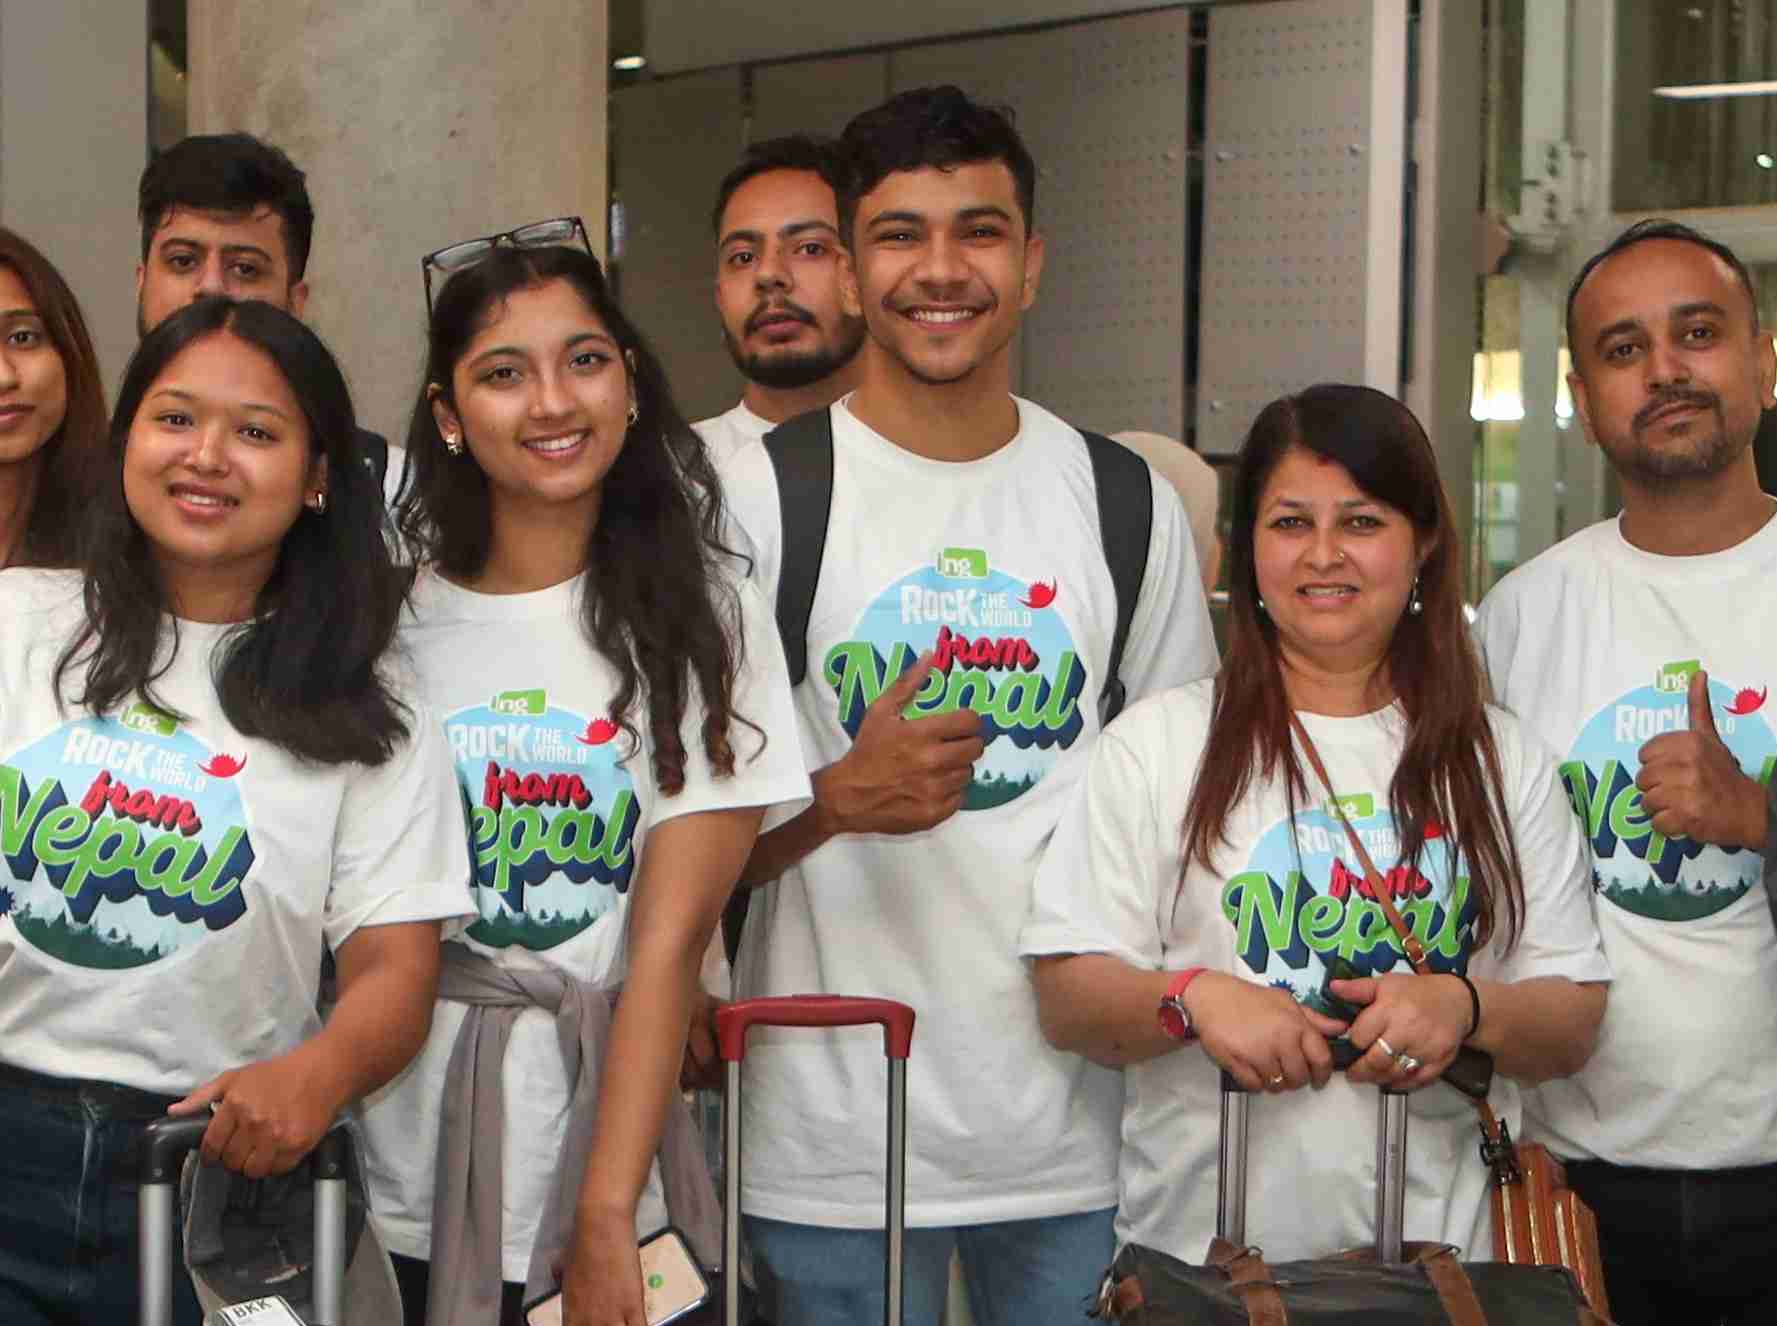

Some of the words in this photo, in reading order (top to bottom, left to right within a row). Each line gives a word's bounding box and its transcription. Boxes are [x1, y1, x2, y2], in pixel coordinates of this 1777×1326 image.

[900, 585, 978, 627] ROCK
[979, 592, 1009, 608] THE
[979, 606, 1033, 628] WORLD
[934, 624, 1039, 673] from
[62, 725, 152, 781] ROCK
[448, 722, 532, 764] ROCK
[533, 743, 588, 765] WORLD
[535, 727, 562, 746] THE
[154, 749, 188, 773] THE
[150, 766, 208, 794] WORLD
[483, 760, 594, 812] from
[80, 769, 202, 836] from
[472, 789, 633, 893] epal
[233, 1298, 273, 1318] BKK
